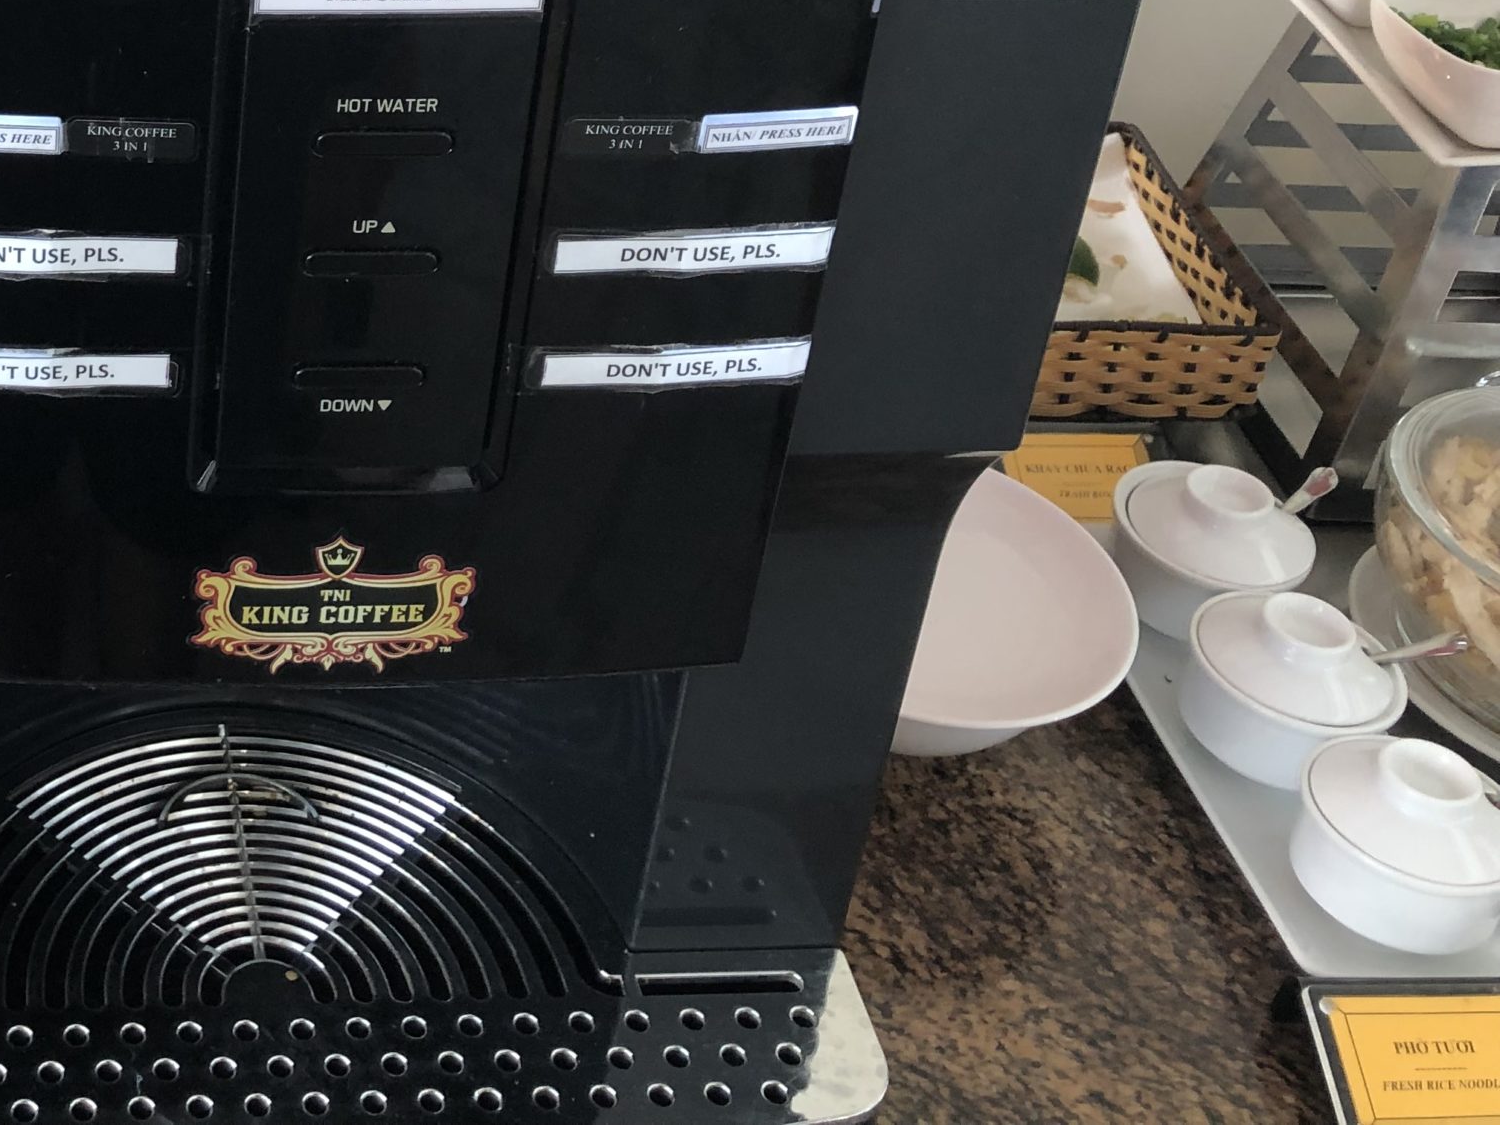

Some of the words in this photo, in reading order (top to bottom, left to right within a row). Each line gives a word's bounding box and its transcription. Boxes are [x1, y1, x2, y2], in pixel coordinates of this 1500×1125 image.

[337, 99, 373, 113] HOT
[377, 98, 439, 113] WATER
[87, 125, 123, 138] KING
[124, 126, 178, 139] COFFEE
[585, 124, 620, 136] KING
[622, 124, 674, 136] COFFEE
[759, 126, 804, 141] PRESS
[805, 123, 846, 137] HERE
[11, 133, 54, 146] HERE
[112, 140, 121, 151] 3
[124, 141, 139, 152] IN
[608, 139, 617, 150] 3
[619, 139, 636, 150] IN
[352, 220, 379, 234] UP
[32, 247, 77, 266] USE,
[84, 247, 125, 263] PLS.
[620, 247, 689, 263] DON'T
[693, 245, 736, 263] USE,
[743, 244, 782, 260] PLS.
[25, 365, 69, 383] USE,
[75, 364, 115, 379] PLS.
[606, 363, 672, 378] DON'T
[677, 361, 718, 377] USE,
[725, 358, 763, 374] PLS.
[320, 399, 374, 413] DOWN
[320, 589, 351, 602] TNI
[240, 605, 310, 625] KING
[319, 604, 426, 624] COFFEE
[1382, 1080, 1423, 1092] FRESH
[1427, 1080, 1456, 1091] RICE
